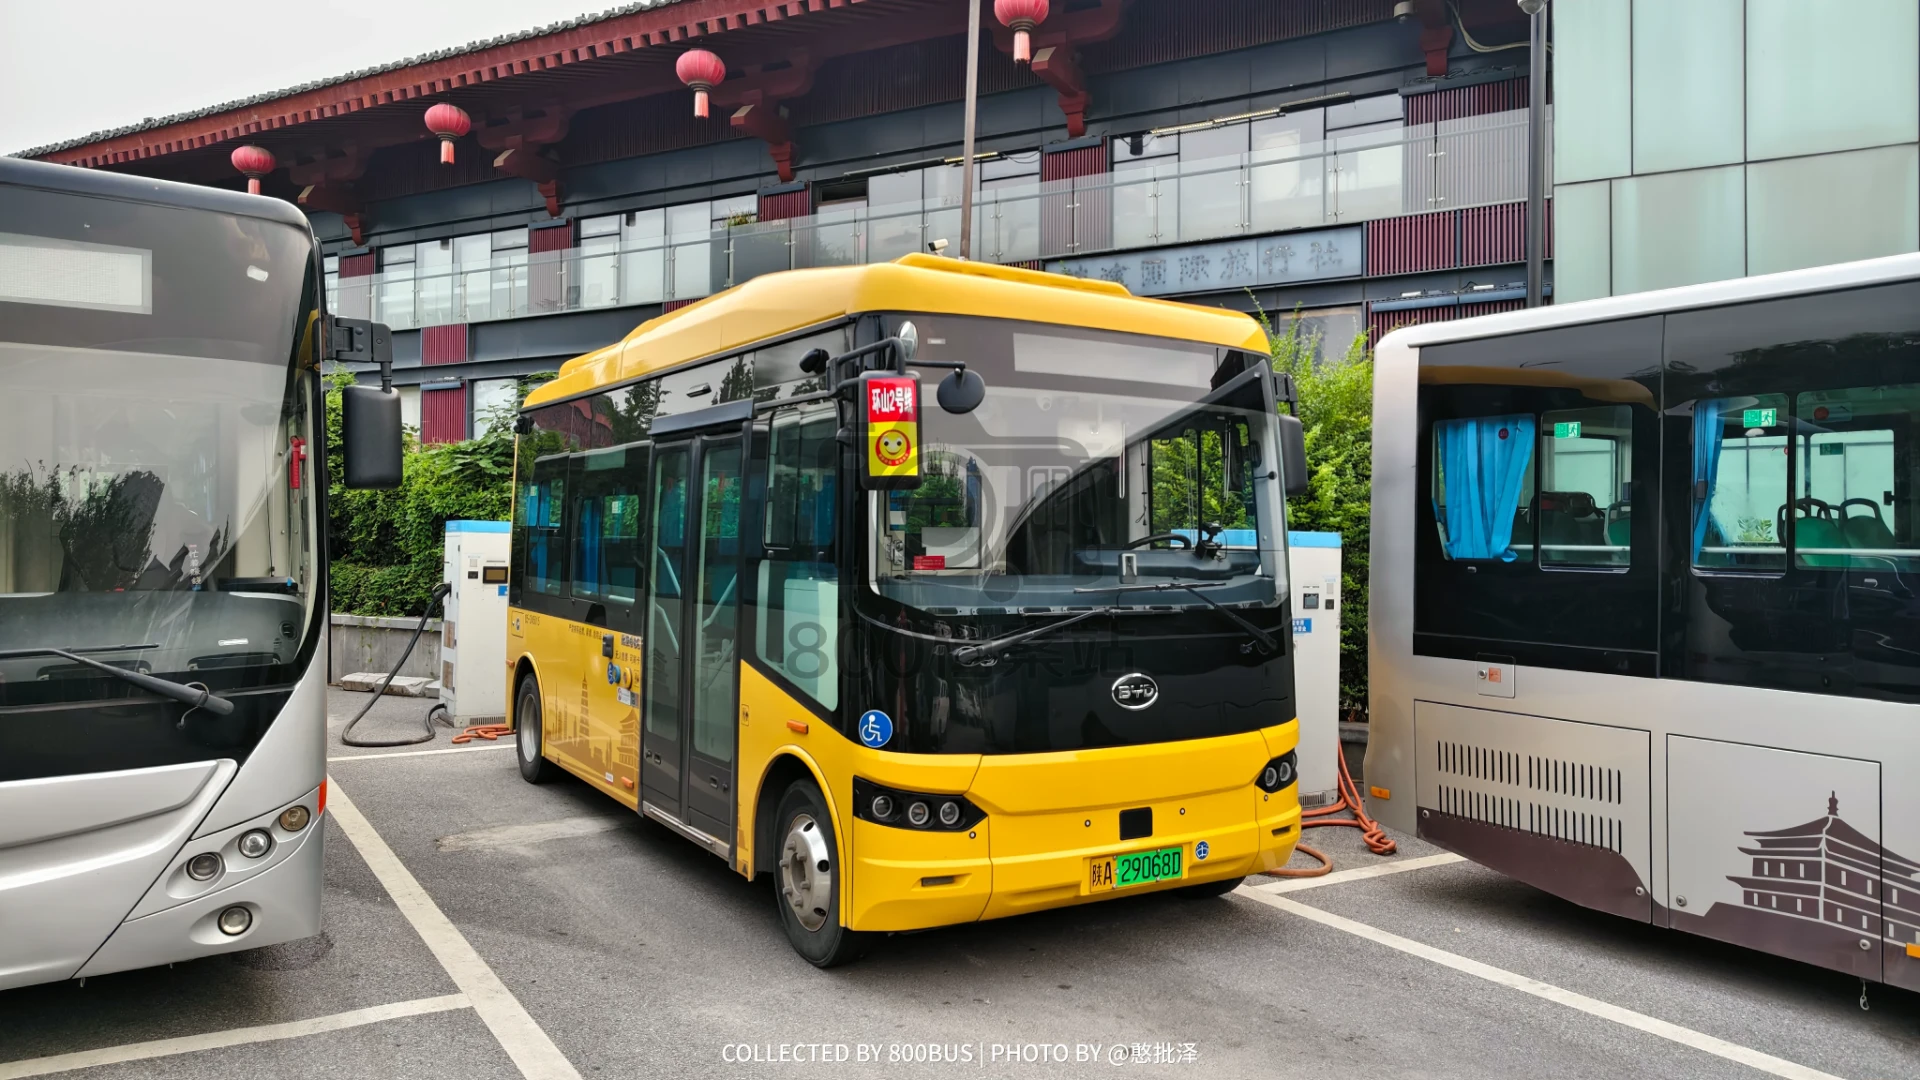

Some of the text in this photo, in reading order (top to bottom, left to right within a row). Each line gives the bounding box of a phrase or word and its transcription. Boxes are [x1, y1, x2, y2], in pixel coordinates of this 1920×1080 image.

[871, 386, 914, 415] 环山2号线
[1118, 684, 1155, 699] BYD
[1121, 851, 1181, 883] 29068D
